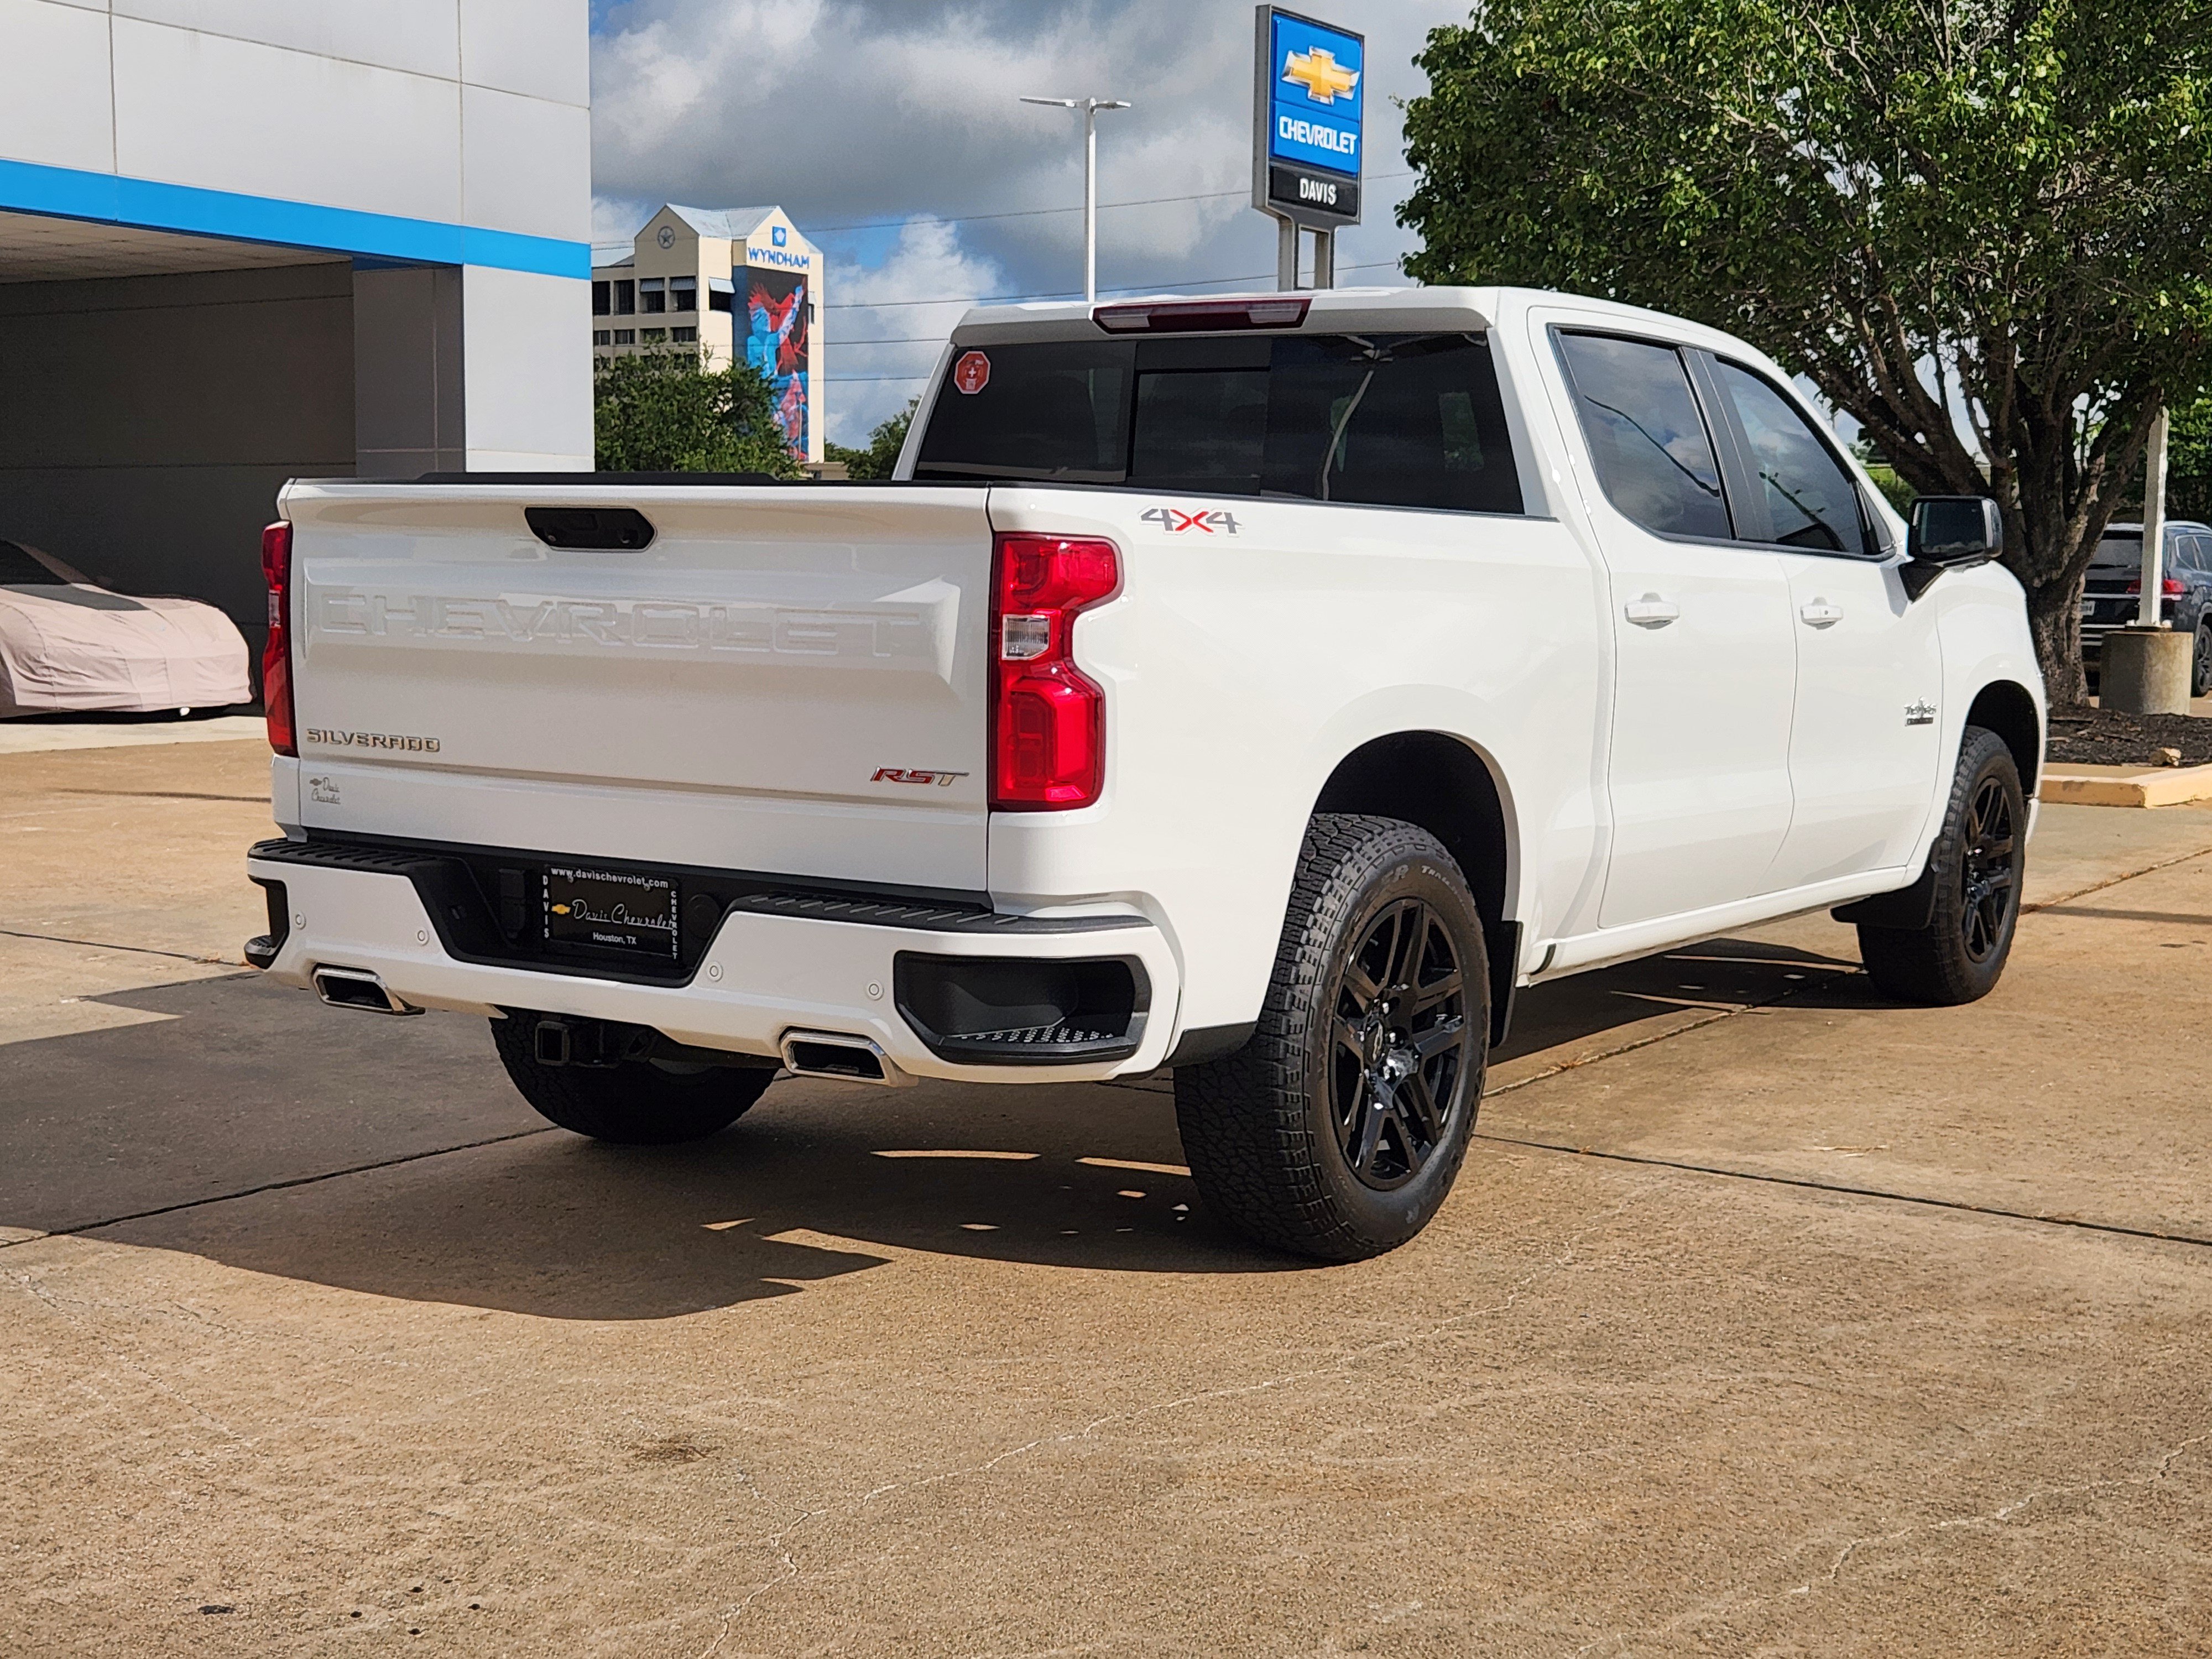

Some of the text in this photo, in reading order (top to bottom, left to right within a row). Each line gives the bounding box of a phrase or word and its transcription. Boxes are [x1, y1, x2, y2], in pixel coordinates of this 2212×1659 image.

[1280, 116, 1358, 155] CHEVROLET
[1300, 178, 1337, 205] DAVIS
[748, 247, 809, 269] WYNDHAM
[321, 593, 920, 657] CHEVROLET
[307, 728, 440, 752] SILVERADO
[870, 766, 969, 786] RST
[551, 868, 669, 888] www.davischevrolet.com
[572, 899, 673, 930] Davis Chevrolet
[593, 932, 637, 945] Houston, TX
